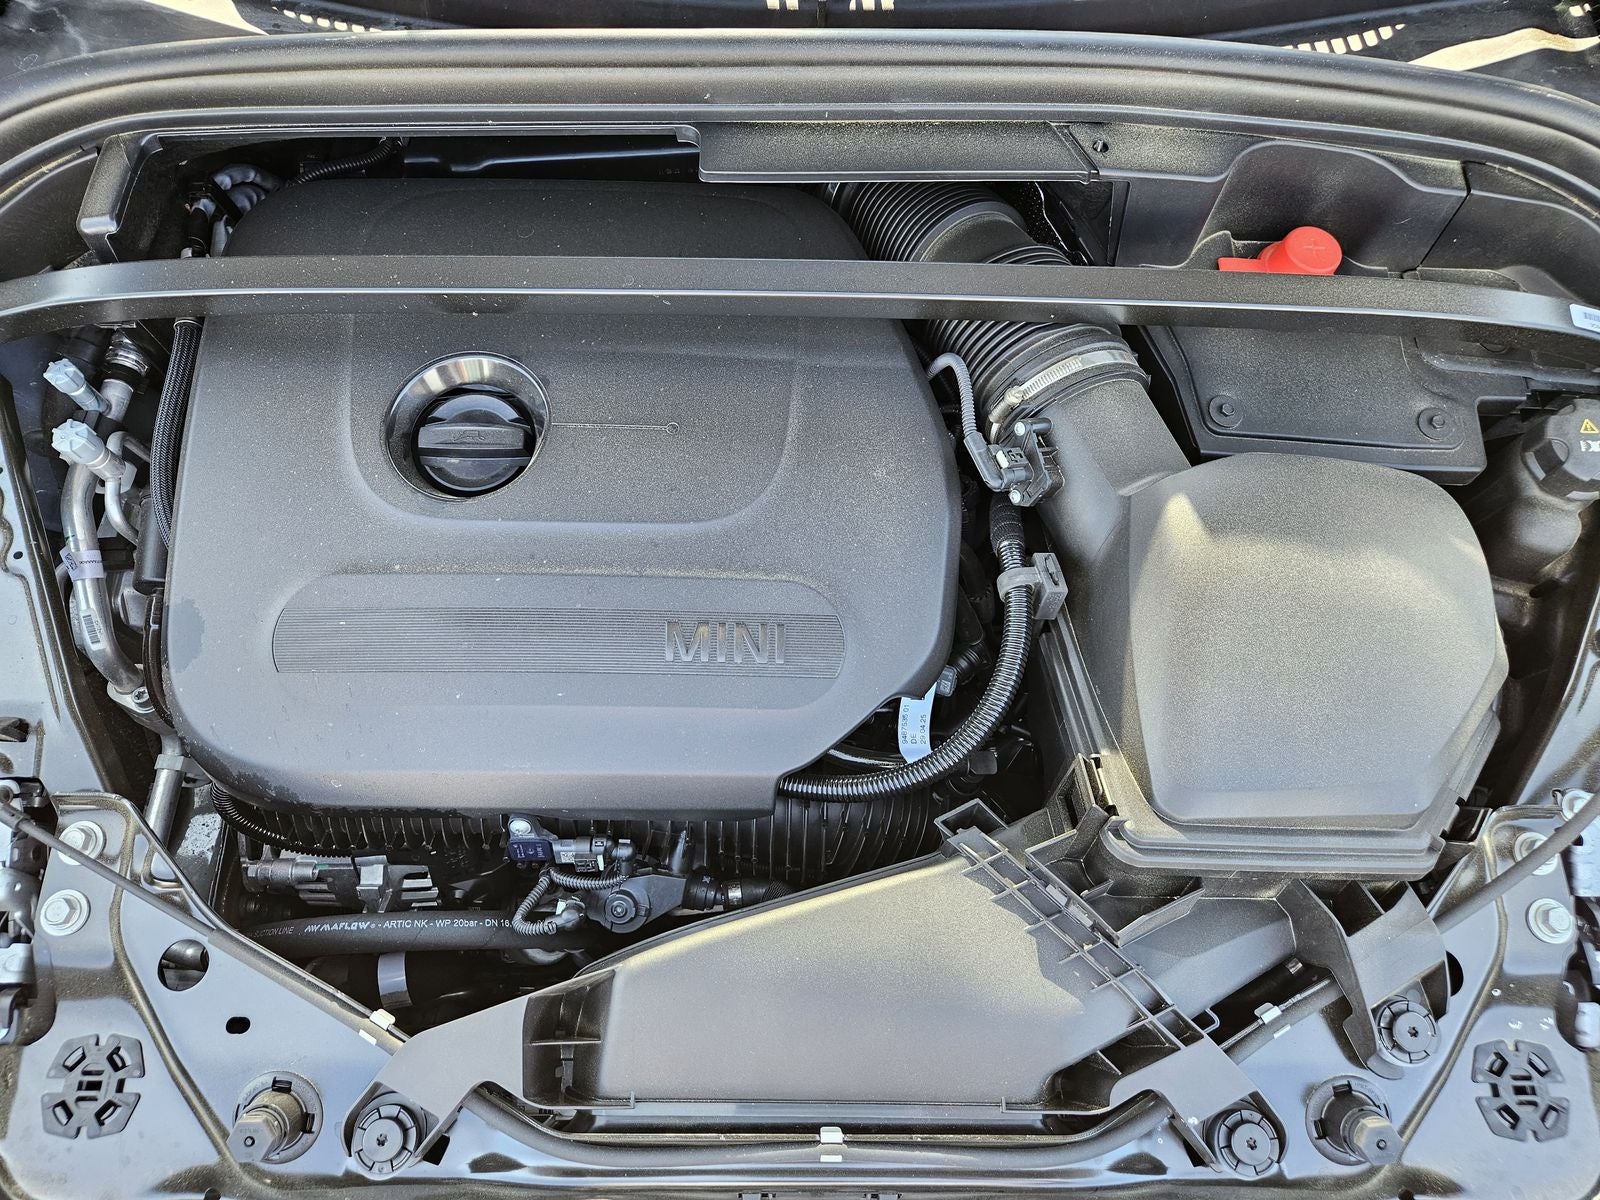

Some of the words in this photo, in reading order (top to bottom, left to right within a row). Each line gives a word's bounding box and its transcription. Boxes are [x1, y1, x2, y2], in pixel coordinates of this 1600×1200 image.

[665, 620, 785, 664] MINI
[383, 920, 412, 929] ARTIC
[414, 919, 428, 928] NK
[435, 919, 451, 928] WP
[453, 919, 478, 928] 20bar
[485, 919, 498, 928] DN
